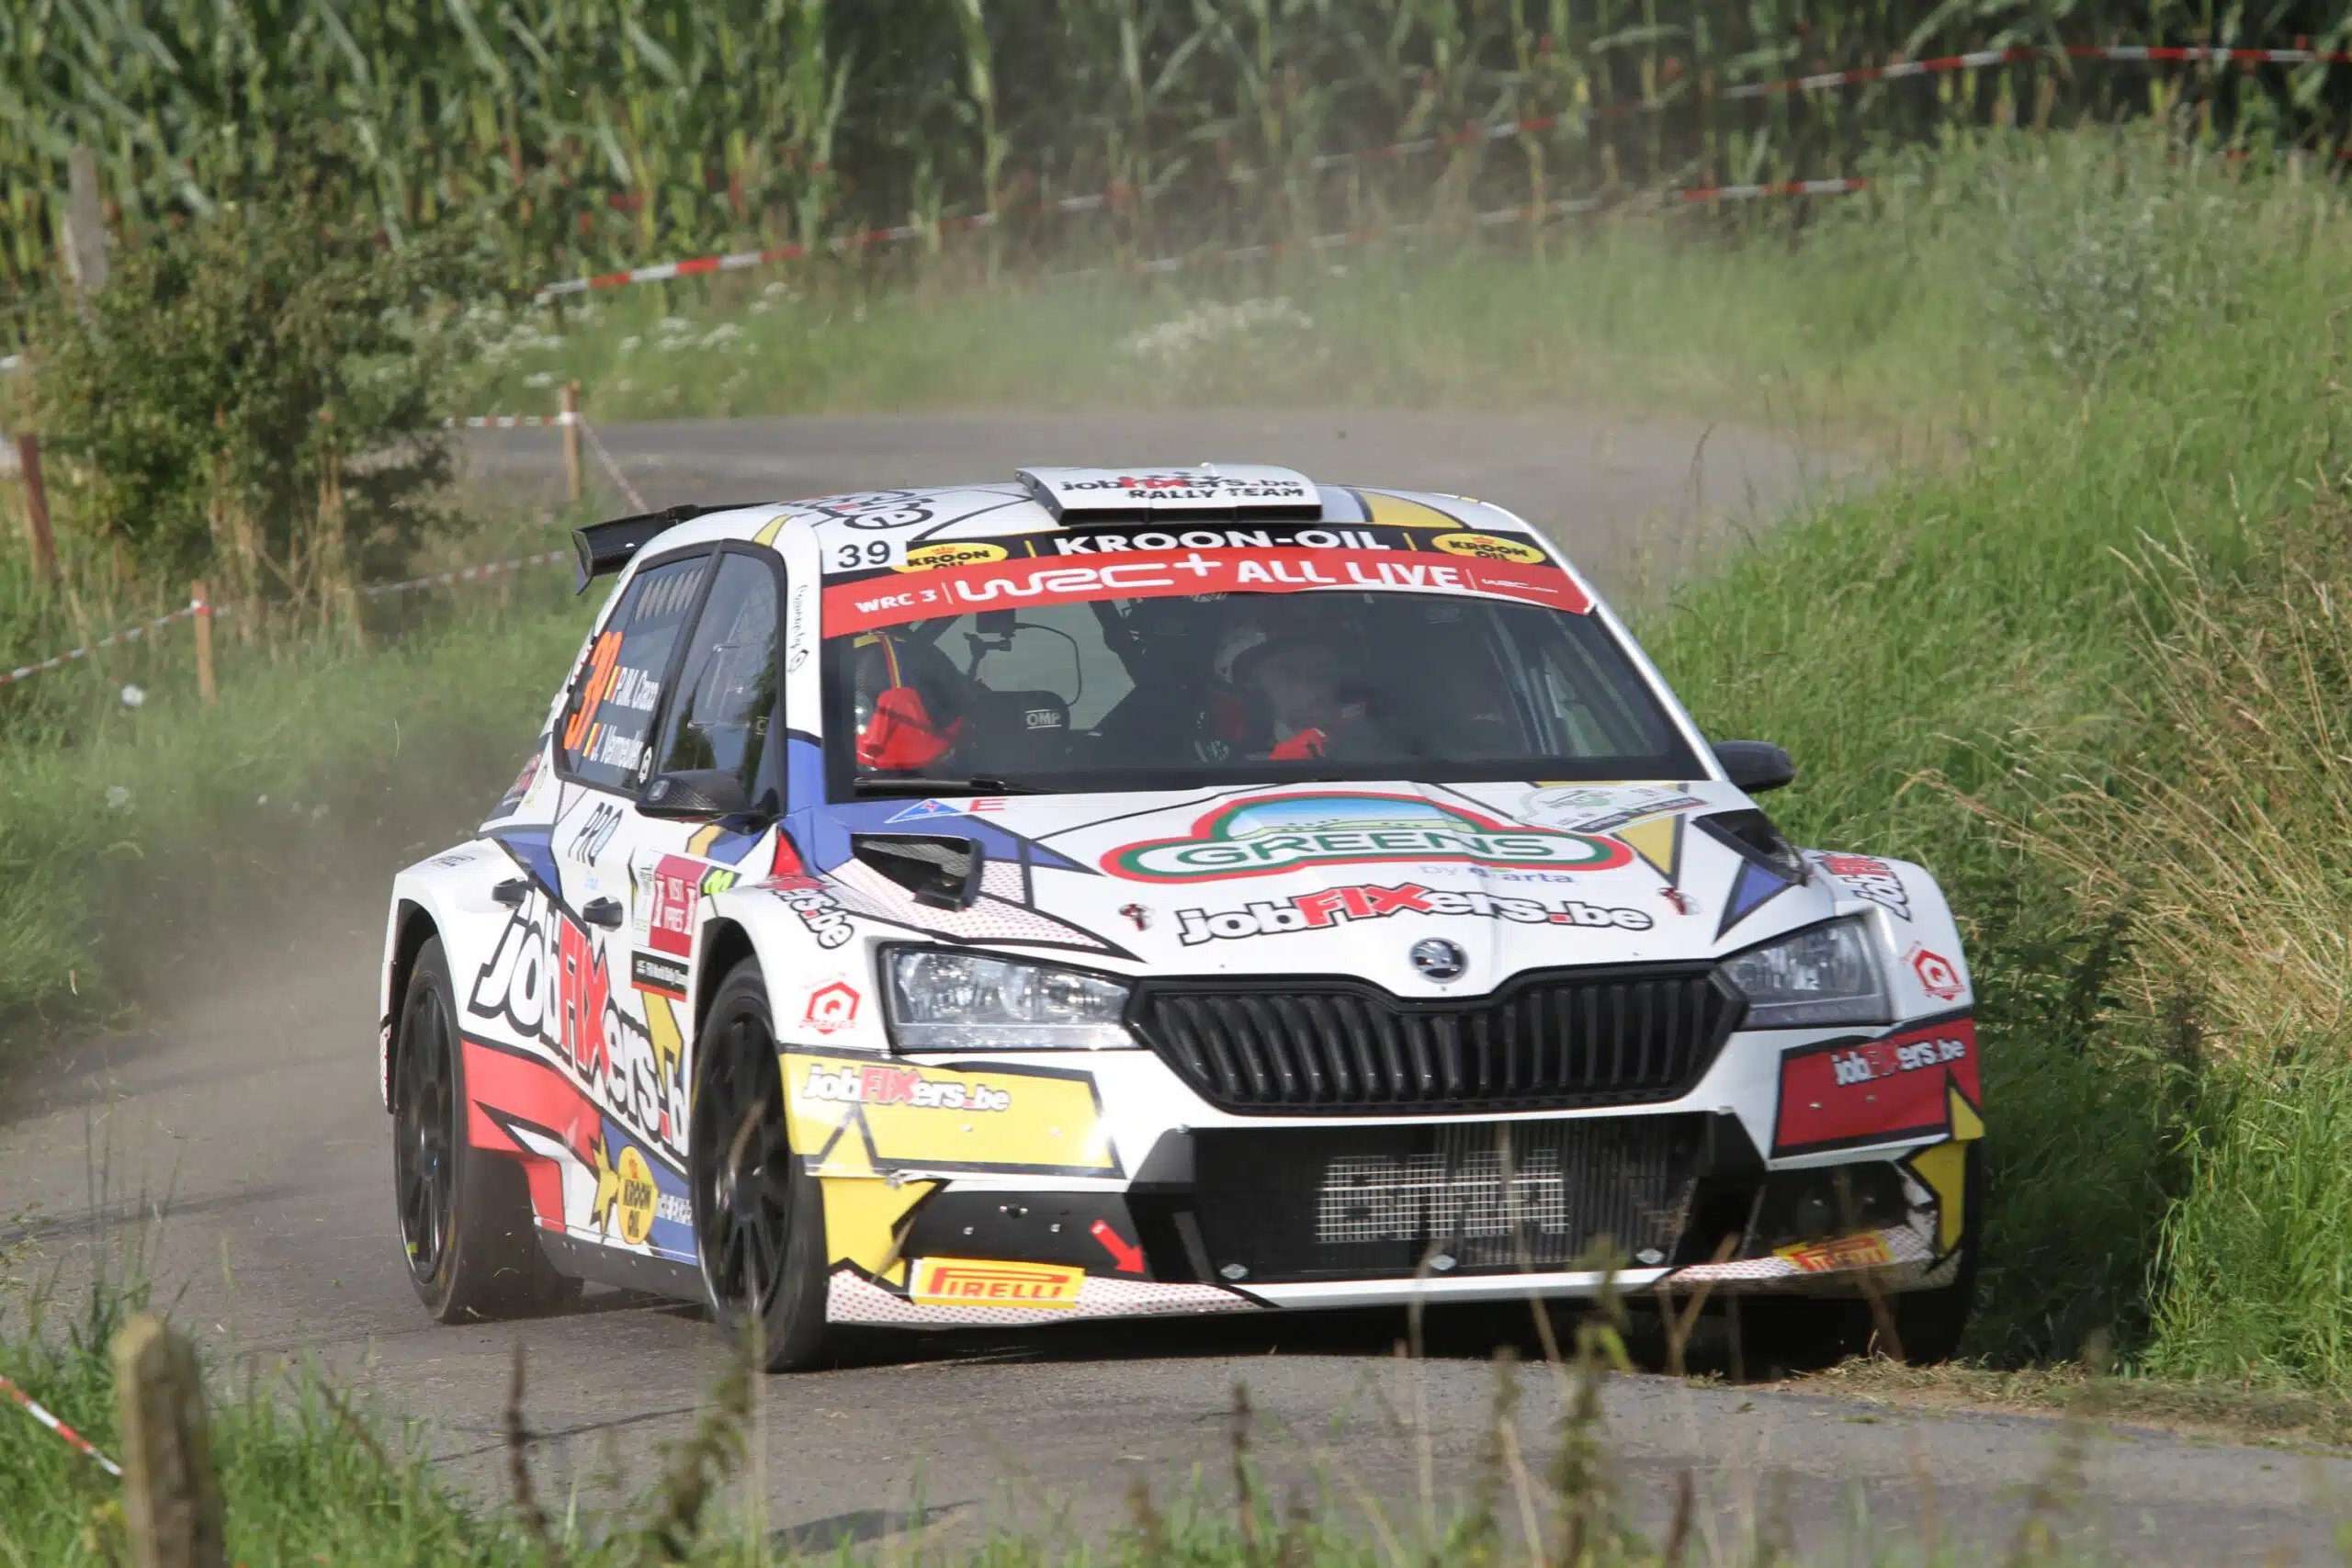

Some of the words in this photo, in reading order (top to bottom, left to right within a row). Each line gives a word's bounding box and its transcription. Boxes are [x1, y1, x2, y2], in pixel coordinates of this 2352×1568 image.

[1128, 489, 1216, 499] RALLY
[1222, 487, 1305, 498] TEAM
[837, 539, 892, 570] 39
[1054, 530, 1391, 556] KROON-OIL
[1447, 539, 1530, 558] KROON
[907, 549, 991, 568] KROON
[1237, 560, 1338, 583] ALL
[1344, 561, 1466, 589] LIVE
[855, 592, 915, 614] WRC
[921, 589, 937, 603] 3
[969, 797, 1009, 813] E
[567, 801, 624, 868] PRO
[1176, 832, 1555, 865] GREENS
[1176, 883, 1654, 946] jobFIXers.be
[467, 886, 690, 1161] jobFIXers.b
[802, 1064, 1011, 1111] jobFIXers.be
[928, 1267, 1071, 1300] PIRELLI
